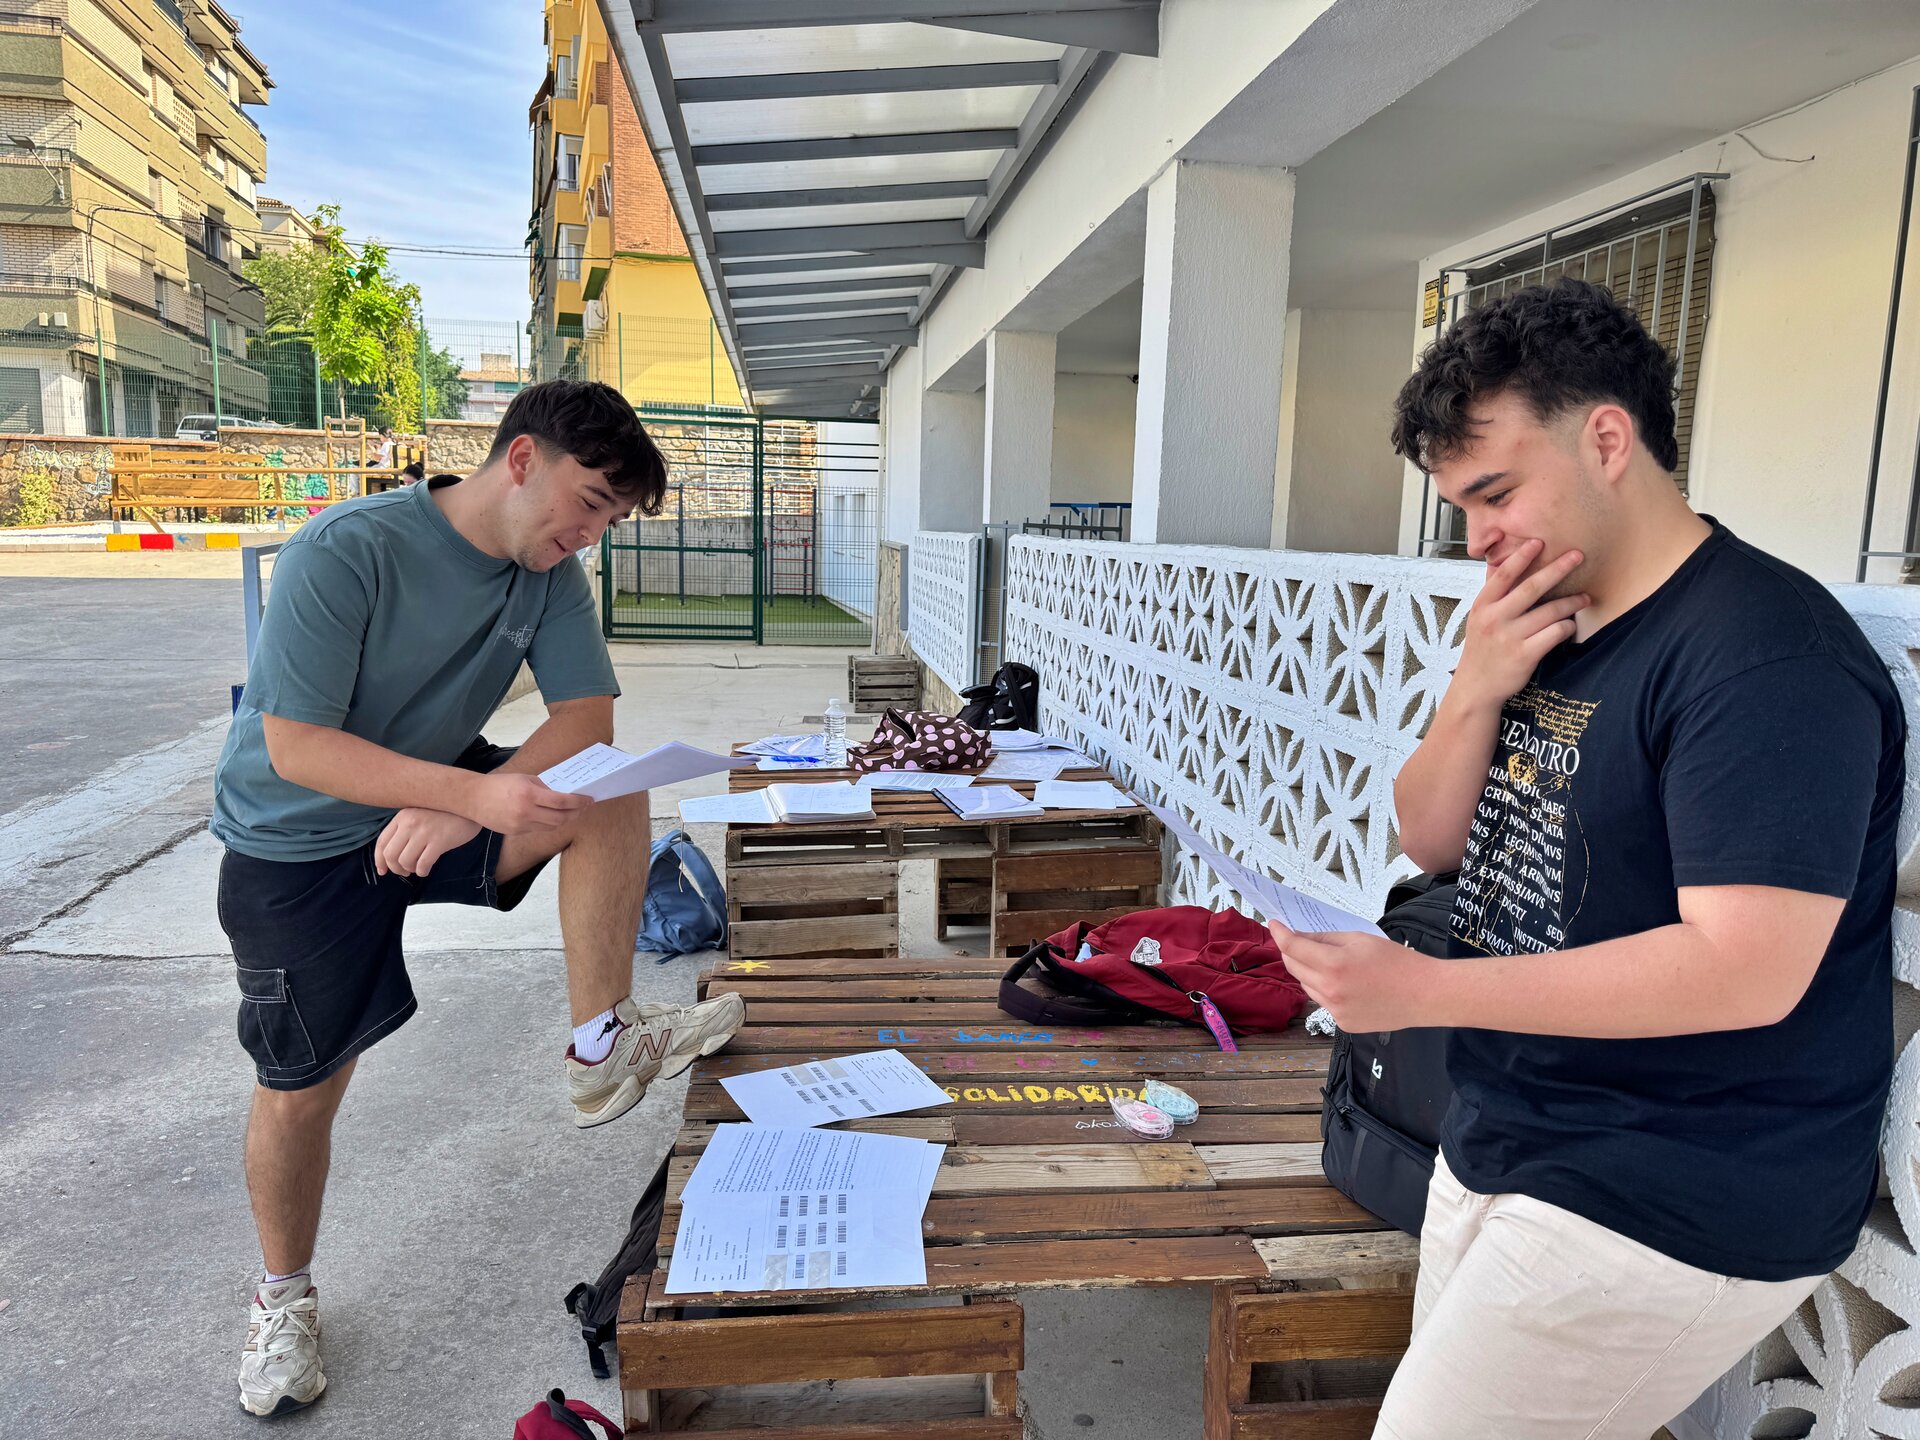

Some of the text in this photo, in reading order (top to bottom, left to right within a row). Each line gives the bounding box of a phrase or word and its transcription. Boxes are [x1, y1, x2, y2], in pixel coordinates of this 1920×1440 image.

[1455, 896, 1484, 917] NON
[1457, 875, 1482, 896] NON
[1545, 924, 1563, 942] SED
[1480, 928, 1514, 956] SVMVS
[877, 1029, 920, 1043] EL
